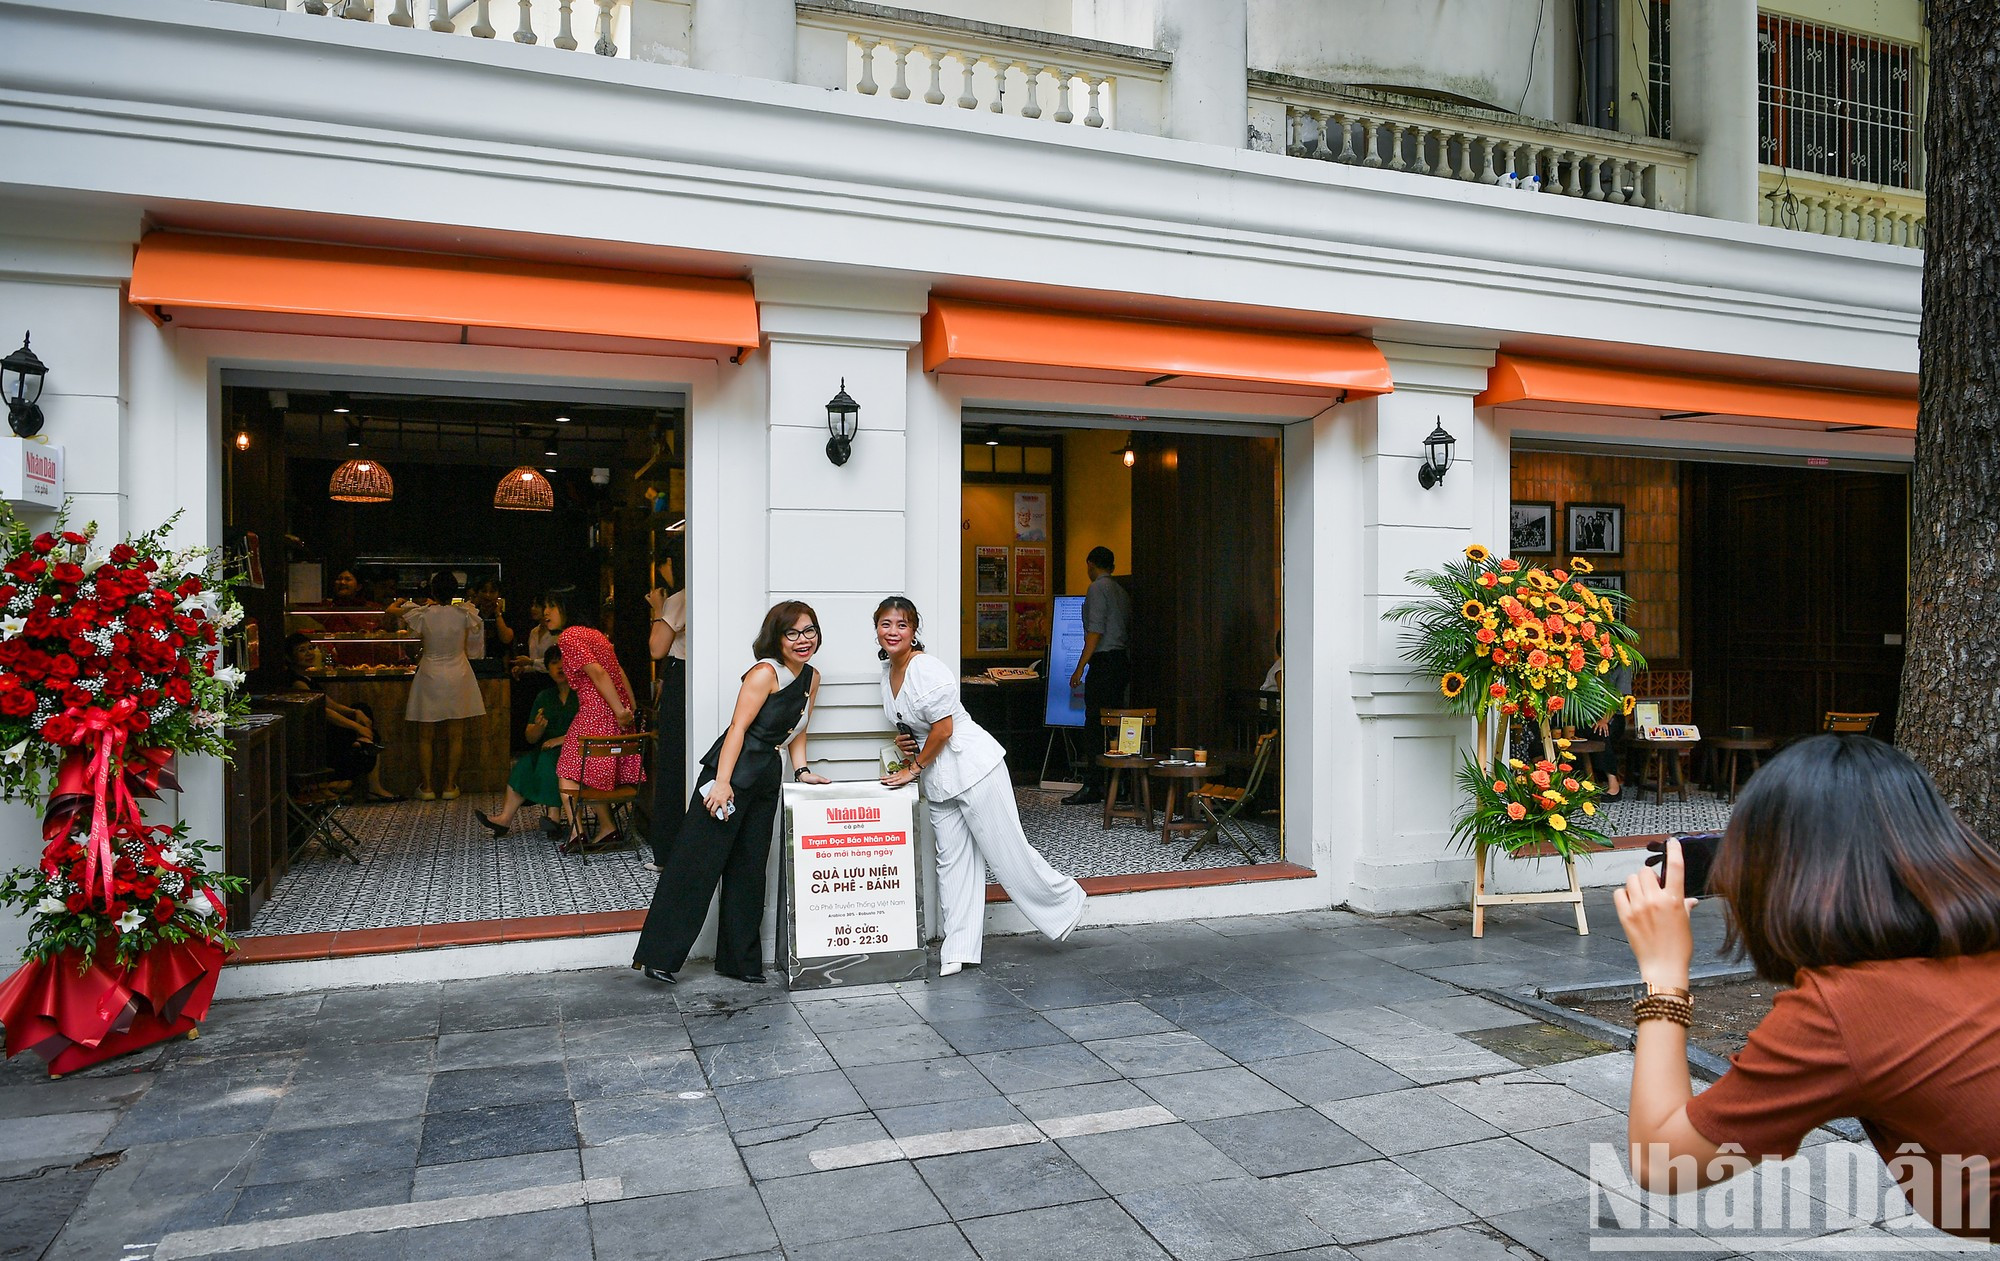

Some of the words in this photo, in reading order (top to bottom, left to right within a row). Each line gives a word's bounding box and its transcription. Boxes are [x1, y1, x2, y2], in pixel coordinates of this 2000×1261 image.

[26, 451, 43, 475] Nhân
[44, 457, 55, 479] Dân
[826, 807, 857, 821] Nhân
[858, 806, 880, 820] Dân
[808, 838, 828, 847] Trạm
[829, 837, 844, 846] Đọc
[847, 835, 862, 844] Báo
[863, 835, 884, 843] Nhân
[885, 834, 901, 842] Dân
[851, 849, 872, 858] hàng
[874, 848, 894, 857] ngày
[812, 866, 840, 880] QUÀ
[843, 867, 865, 879] LƯU
[869, 864, 898, 879] NIỆM
[811, 880, 830, 894] CÀ
[833, 879, 856, 892] PHÊ
[866, 877, 900, 890] BÁNH
[876, 899, 889, 907] Việt
[835, 924, 852, 935] Mở
[855, 923, 879, 934] cửa:
[827, 937, 850, 947] 7:00
[859, 934, 889, 945] 22:30
